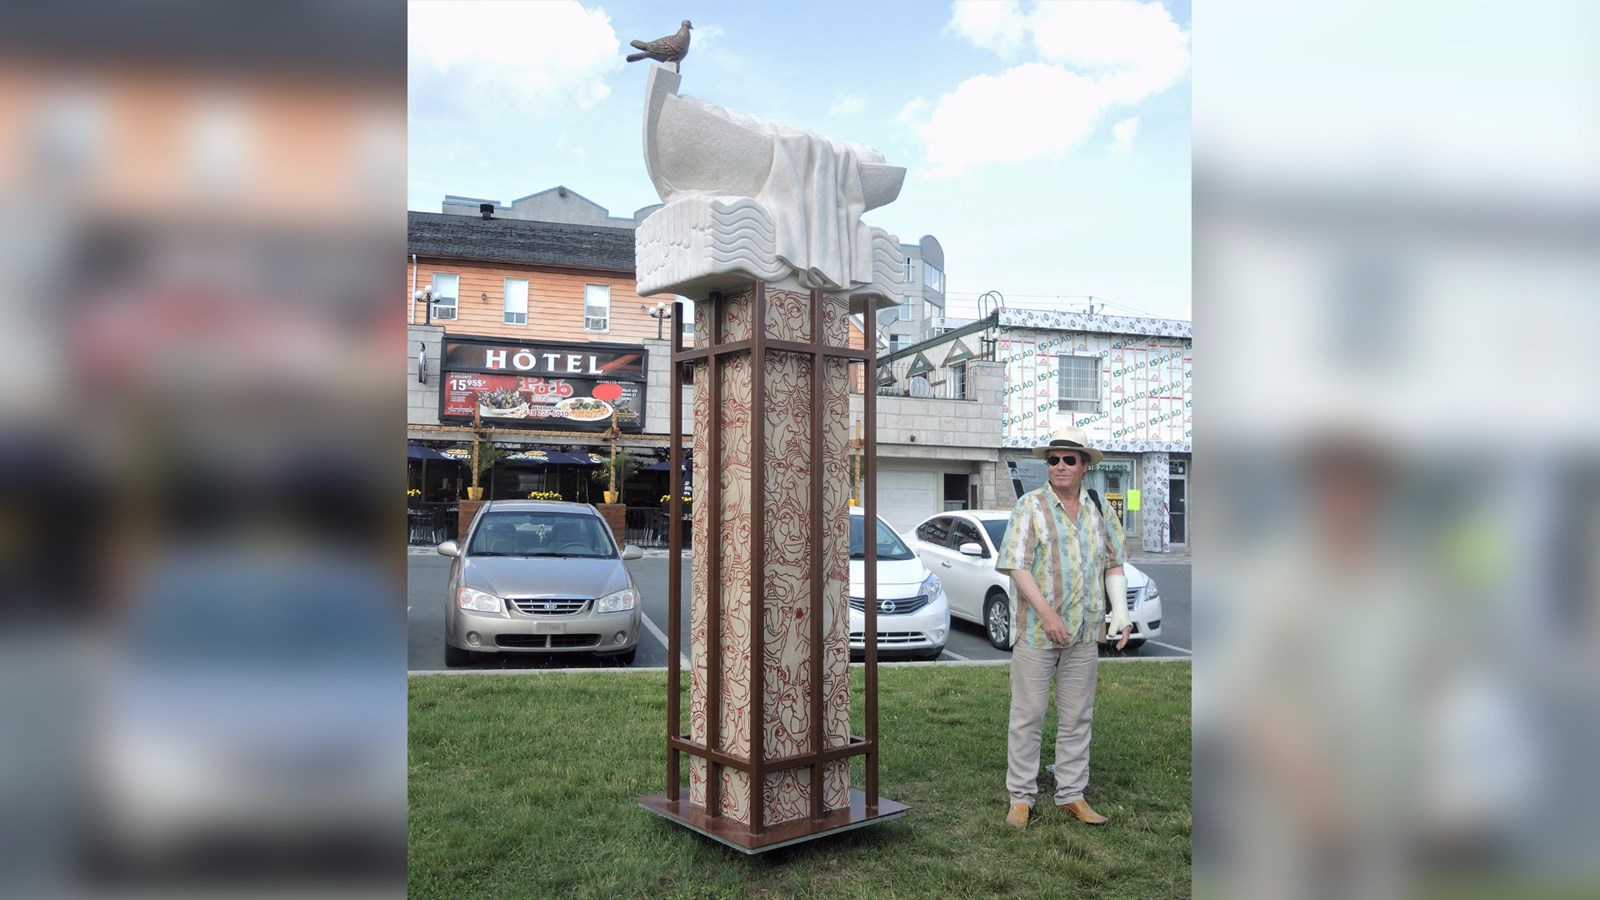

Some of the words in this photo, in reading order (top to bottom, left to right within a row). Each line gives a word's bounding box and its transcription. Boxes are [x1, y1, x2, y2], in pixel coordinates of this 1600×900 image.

[485, 348, 604, 374] HÔTEL
[1149, 351, 1182, 367] ISOCLAD
[1113, 361, 1146, 378] ISOCLAD
[1149, 381, 1182, 396] ISOCLAD
[1113, 391, 1146, 408] ISOCLAD
[1076, 410, 1108, 428] ISOCLAD
[1149, 409, 1182, 426] ISOCLAD
[1113, 422, 1146, 438] ISOCLAD
